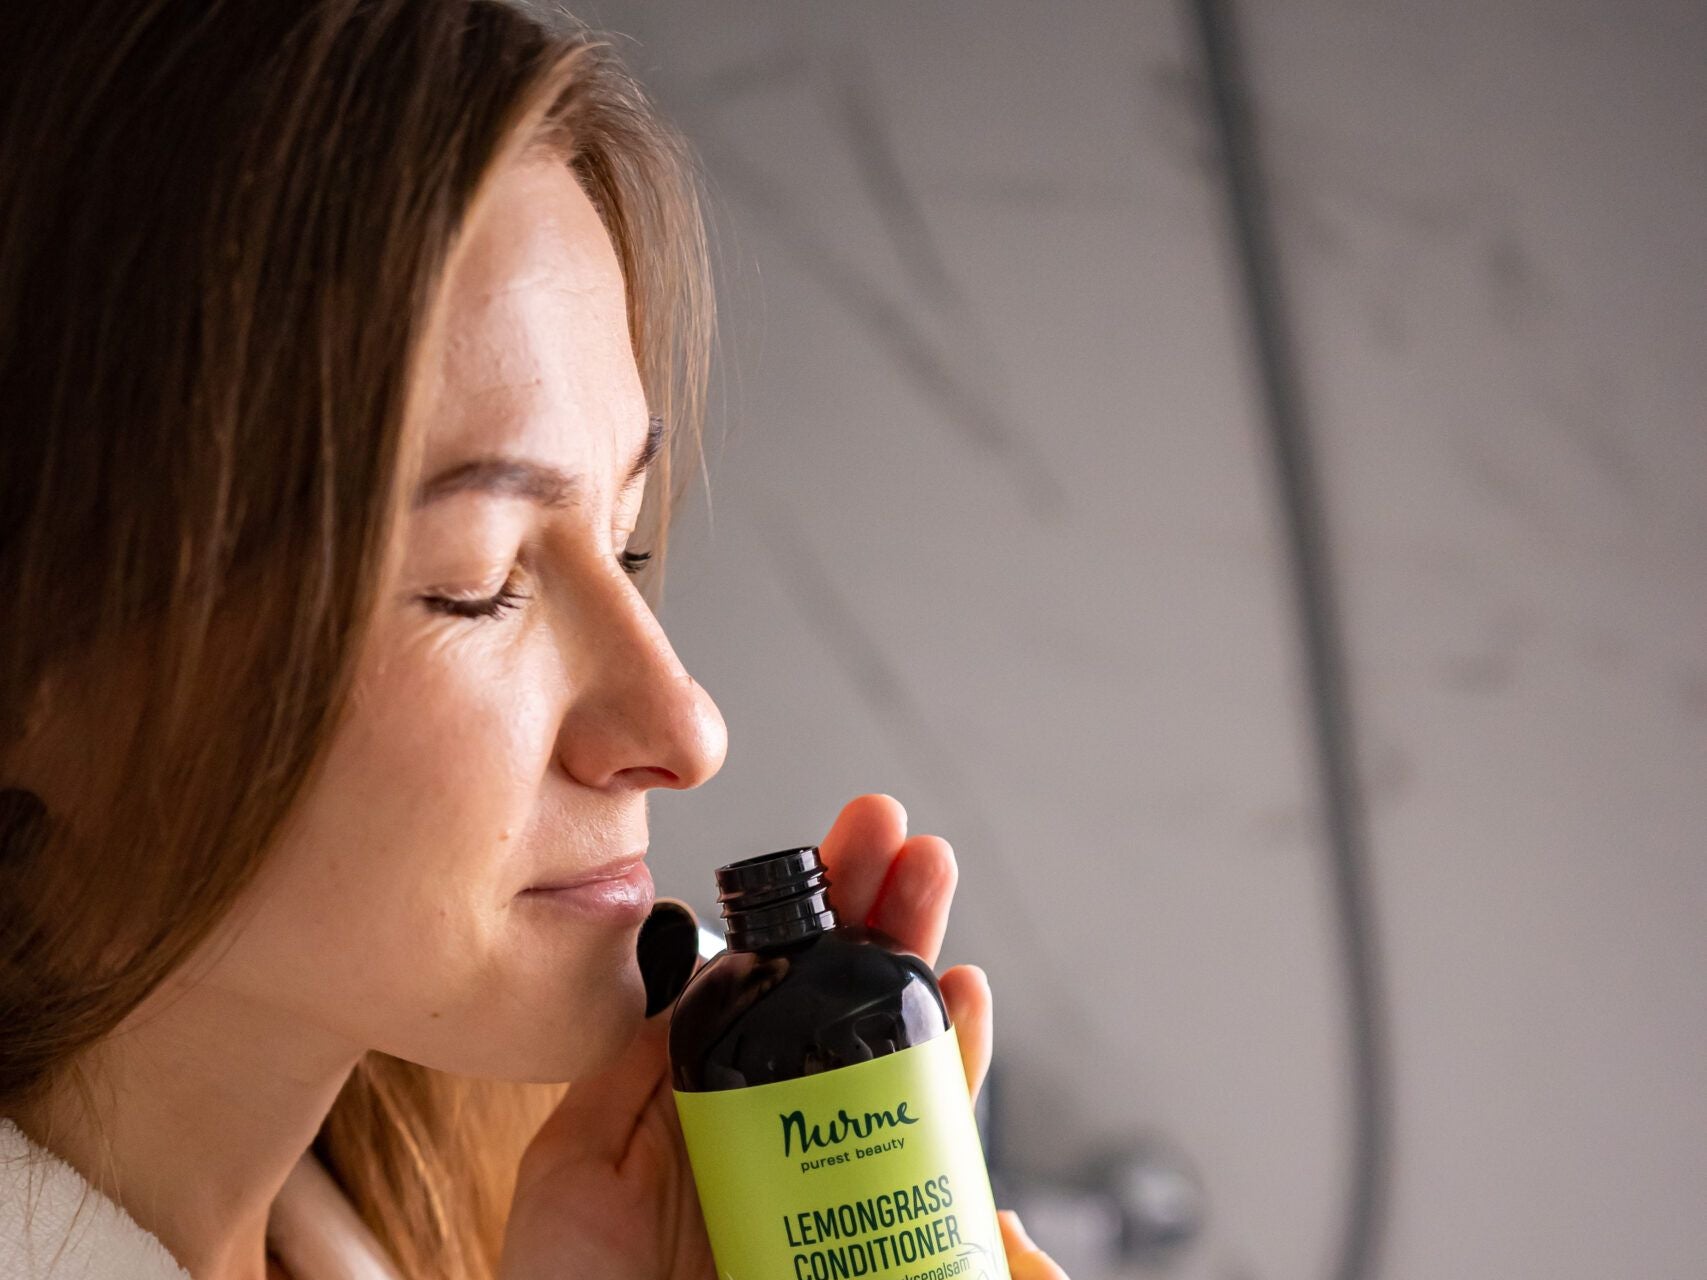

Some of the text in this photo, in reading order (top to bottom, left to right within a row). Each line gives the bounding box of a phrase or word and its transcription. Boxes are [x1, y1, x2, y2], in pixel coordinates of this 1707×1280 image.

[779, 1101, 920, 1158] Nurme
[800, 1136, 905, 1173] purest beauty
[783, 1174, 954, 1248] LEMONGRASS
